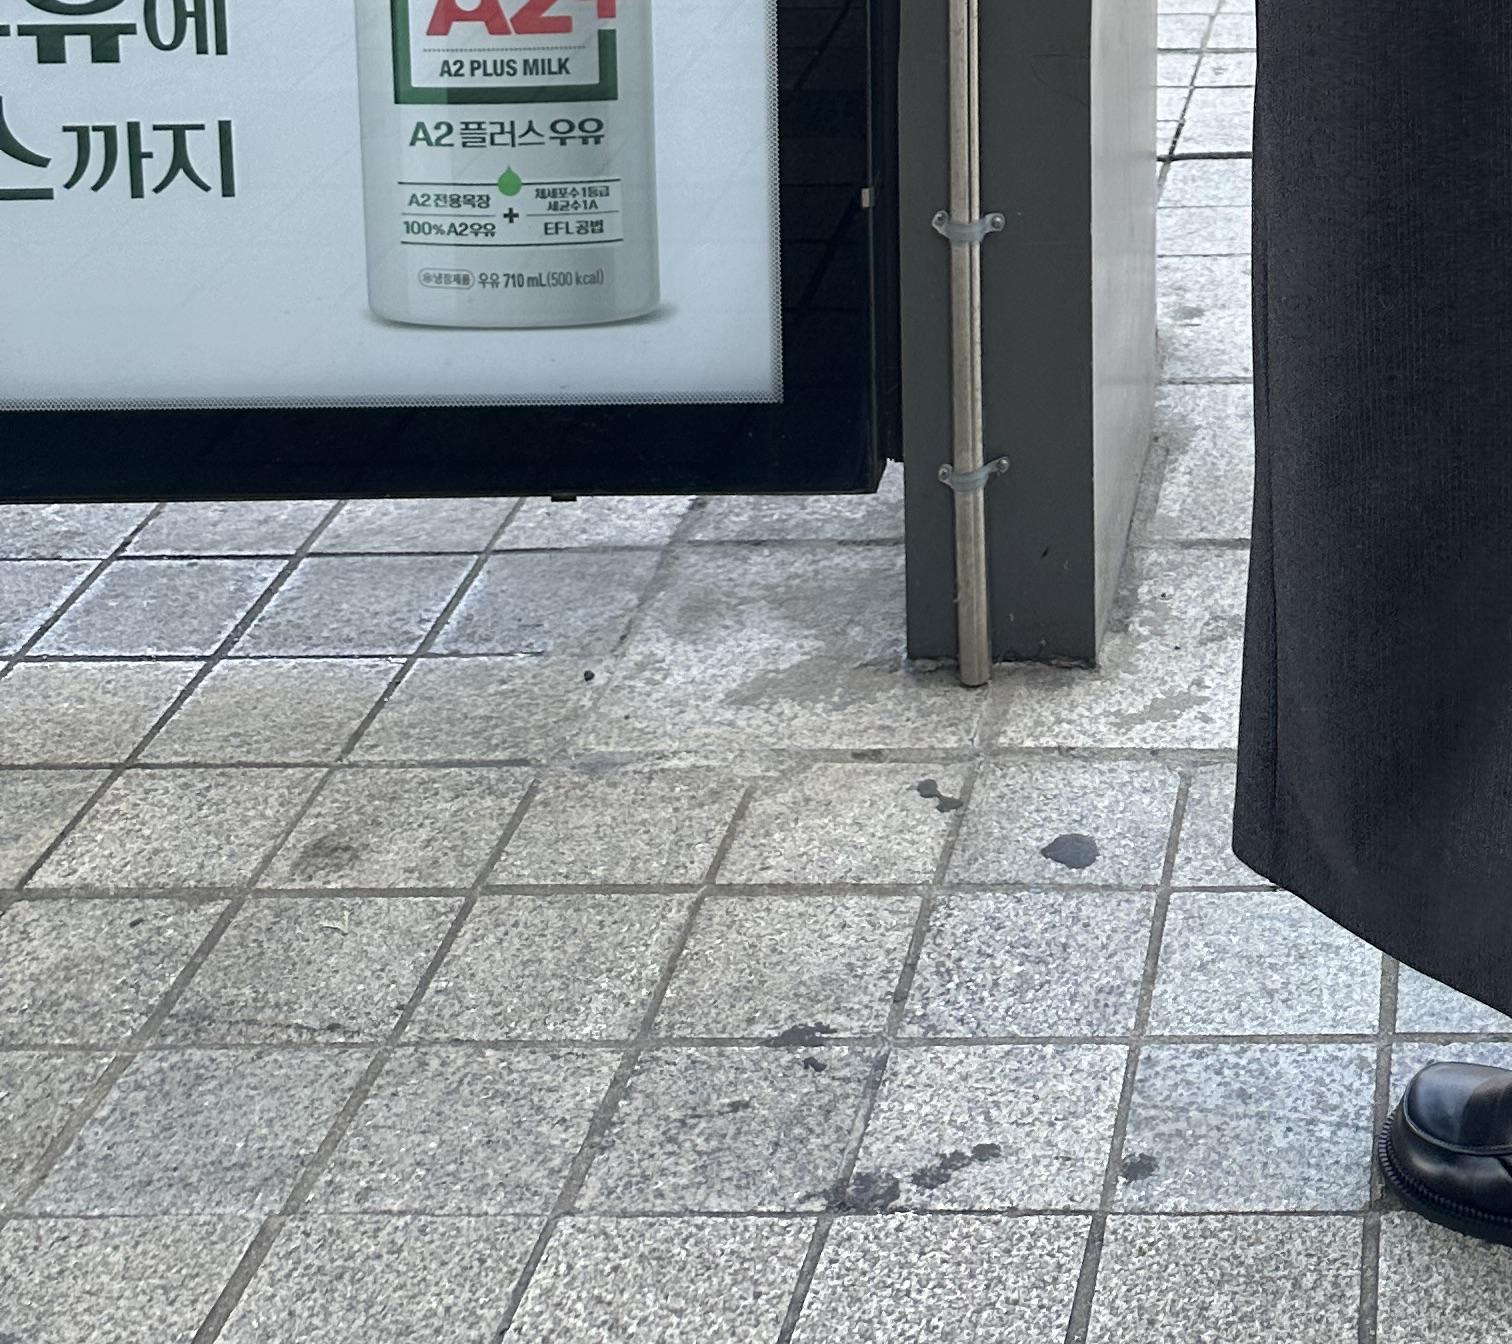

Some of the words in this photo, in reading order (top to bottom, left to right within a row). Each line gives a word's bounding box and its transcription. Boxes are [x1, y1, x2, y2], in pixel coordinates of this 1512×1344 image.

[439, 59, 465, 78] A2
[470, 58, 518, 77] PLUS
[522, 57, 571, 76] MILK
[478, 272, 500, 289] 우유
[502, 273, 524, 289] 710
